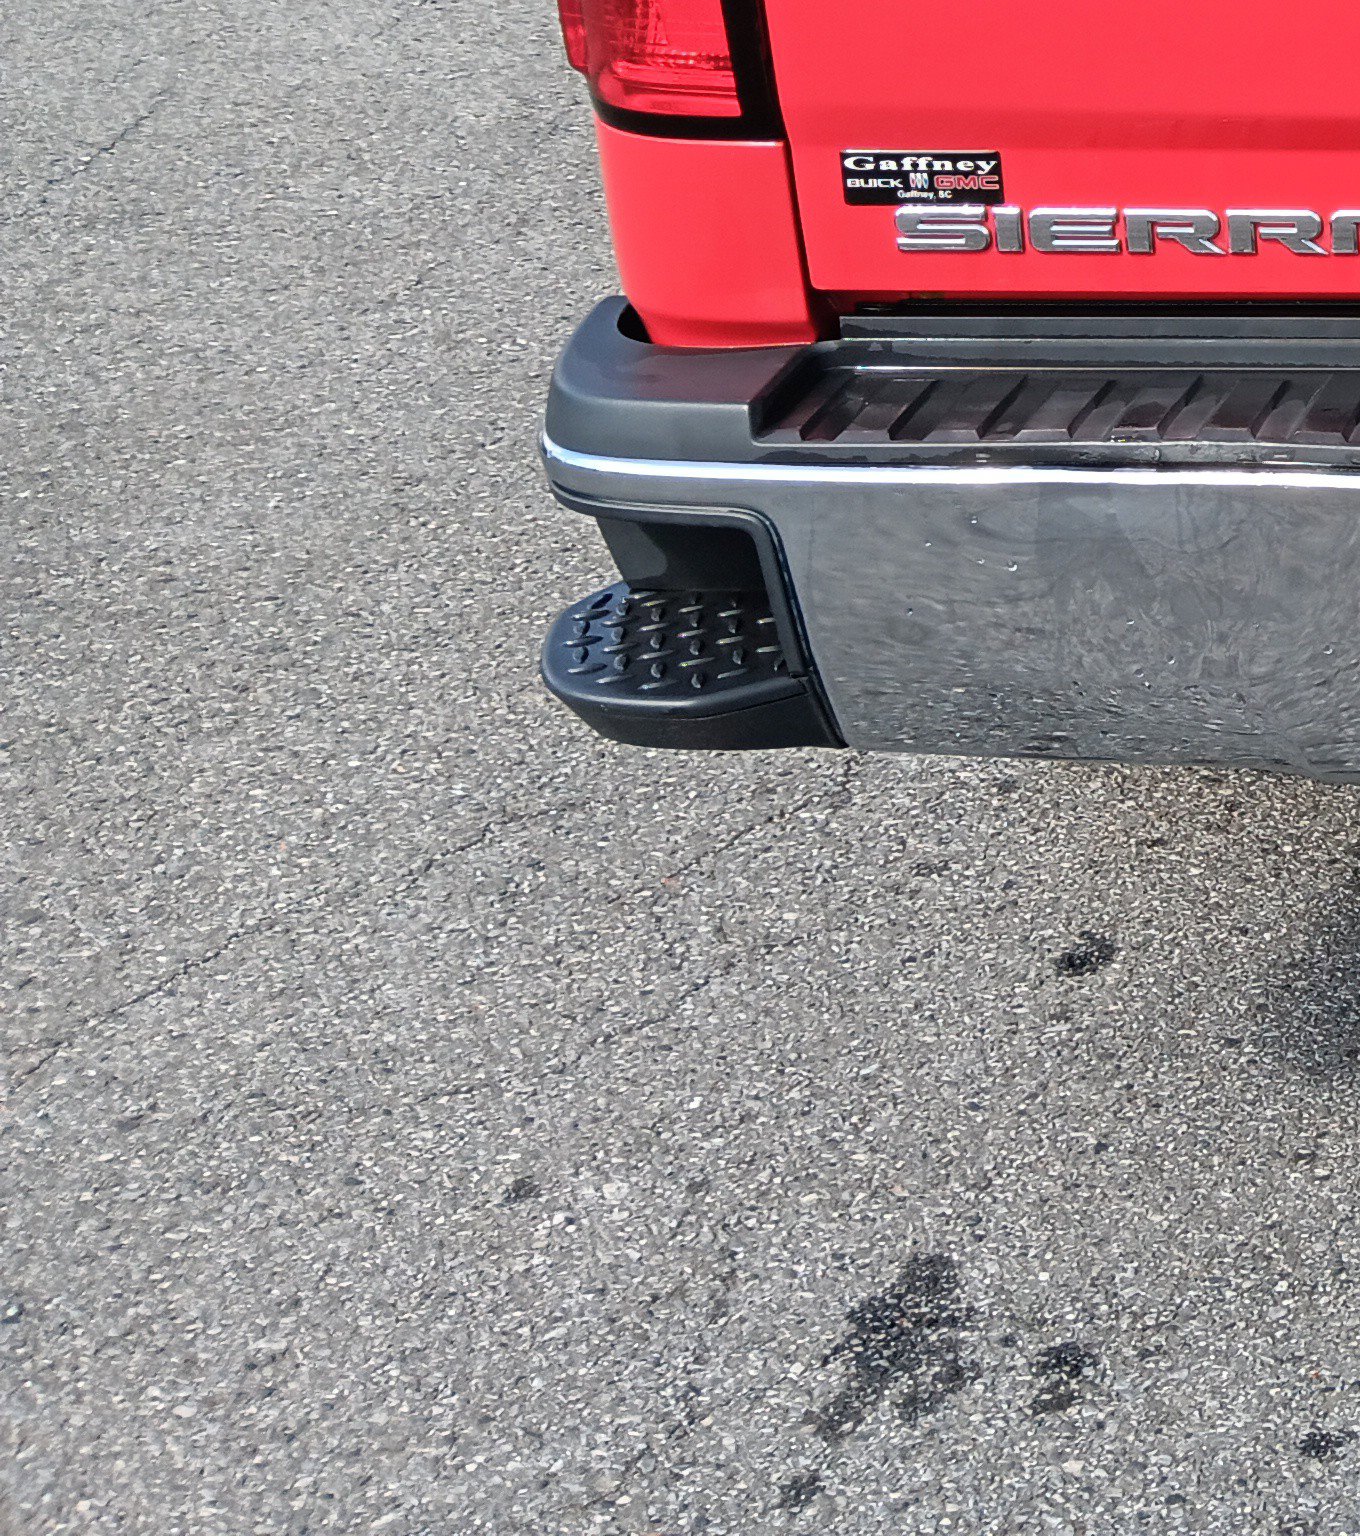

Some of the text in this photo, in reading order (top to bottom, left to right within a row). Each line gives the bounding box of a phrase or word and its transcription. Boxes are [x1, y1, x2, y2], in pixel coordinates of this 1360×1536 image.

[843, 156, 998, 175] Gaffney
[846, 175, 1000, 190] BUICK GMC
